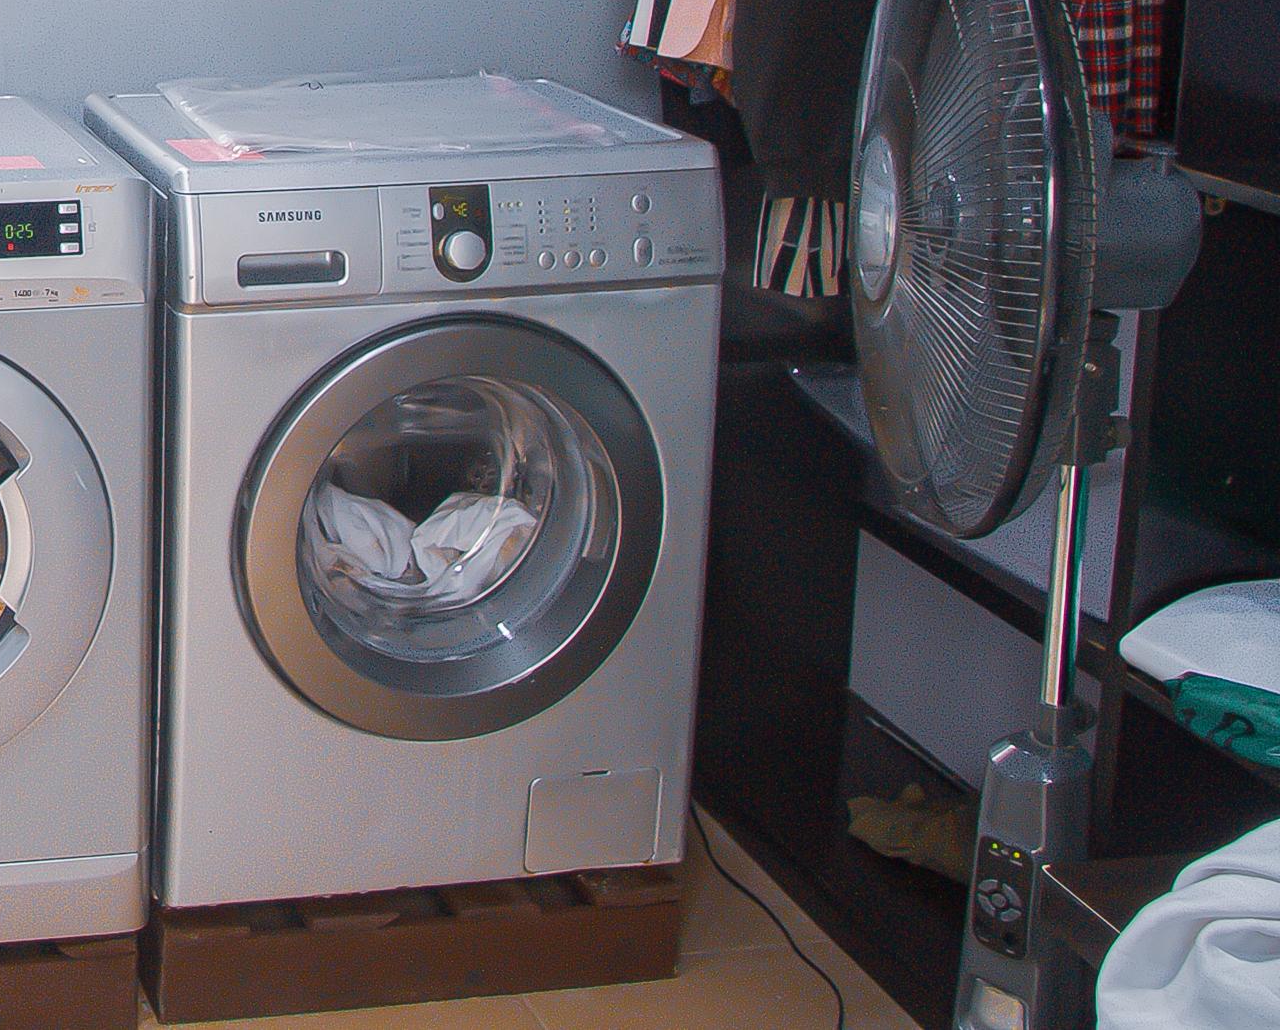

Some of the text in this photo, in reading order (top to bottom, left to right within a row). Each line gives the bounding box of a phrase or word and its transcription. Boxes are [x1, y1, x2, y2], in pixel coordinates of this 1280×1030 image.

[258, 210, 322, 222] SAMSUNG
[5, 223, 33, 239] 0:25
[13, 289, 32, 297] 1400
